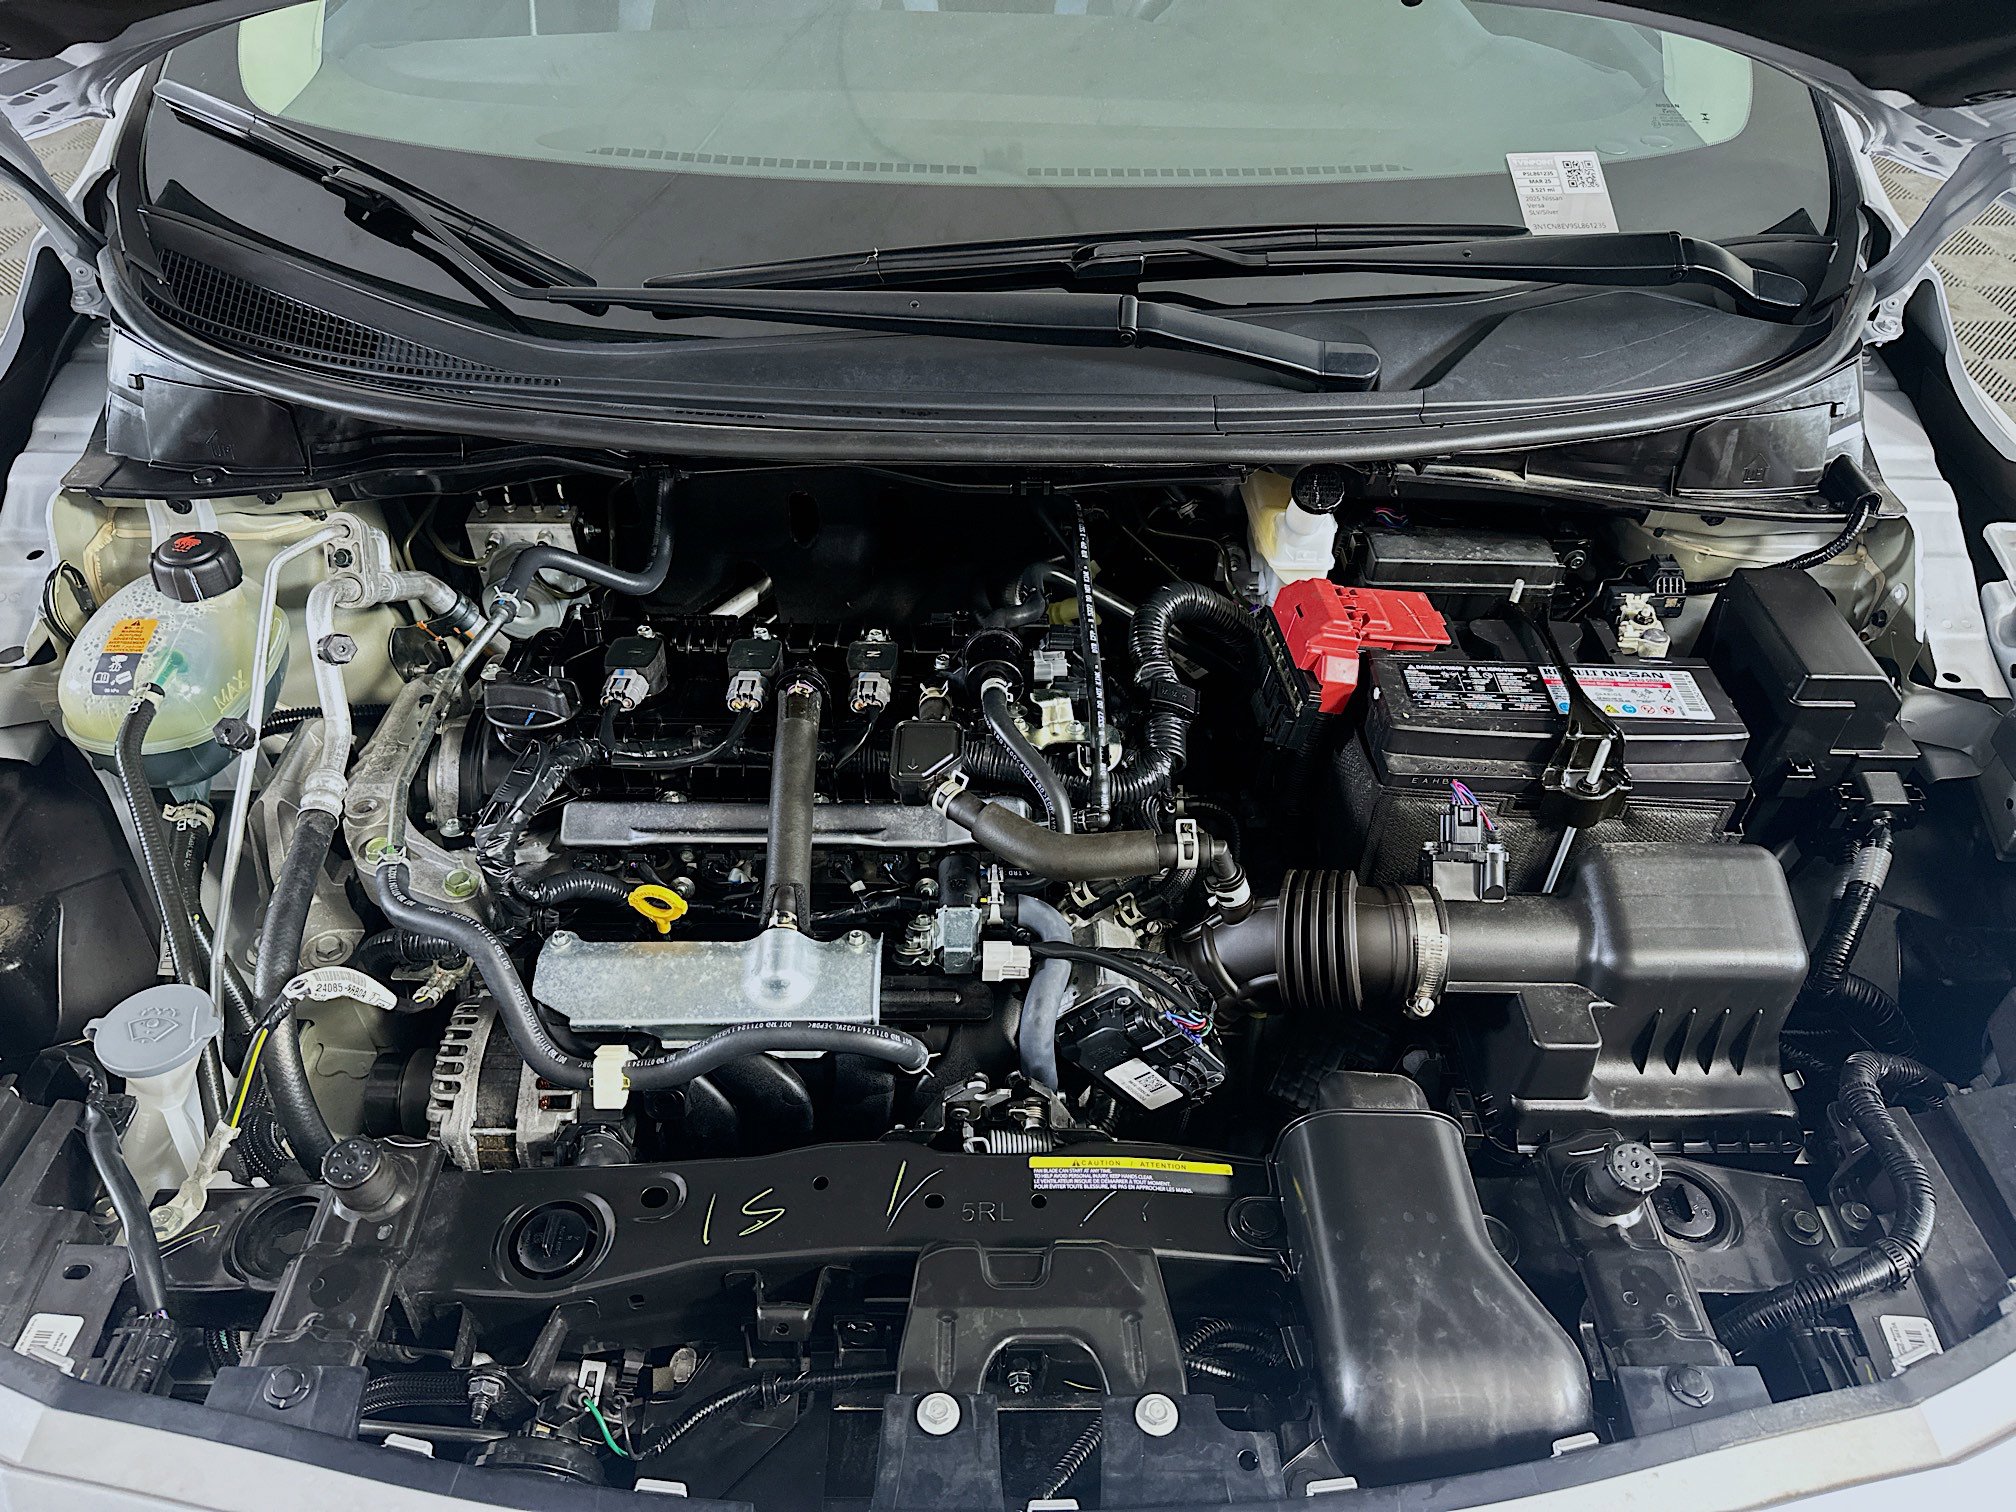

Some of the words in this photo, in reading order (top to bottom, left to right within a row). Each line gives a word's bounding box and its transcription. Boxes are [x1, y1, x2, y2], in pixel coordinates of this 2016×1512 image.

[862, 1027, 889, 1038] 071124
[1140, 1161, 1187, 1170] ATTENTION
[960, 1200, 1014, 1223] 5RL
